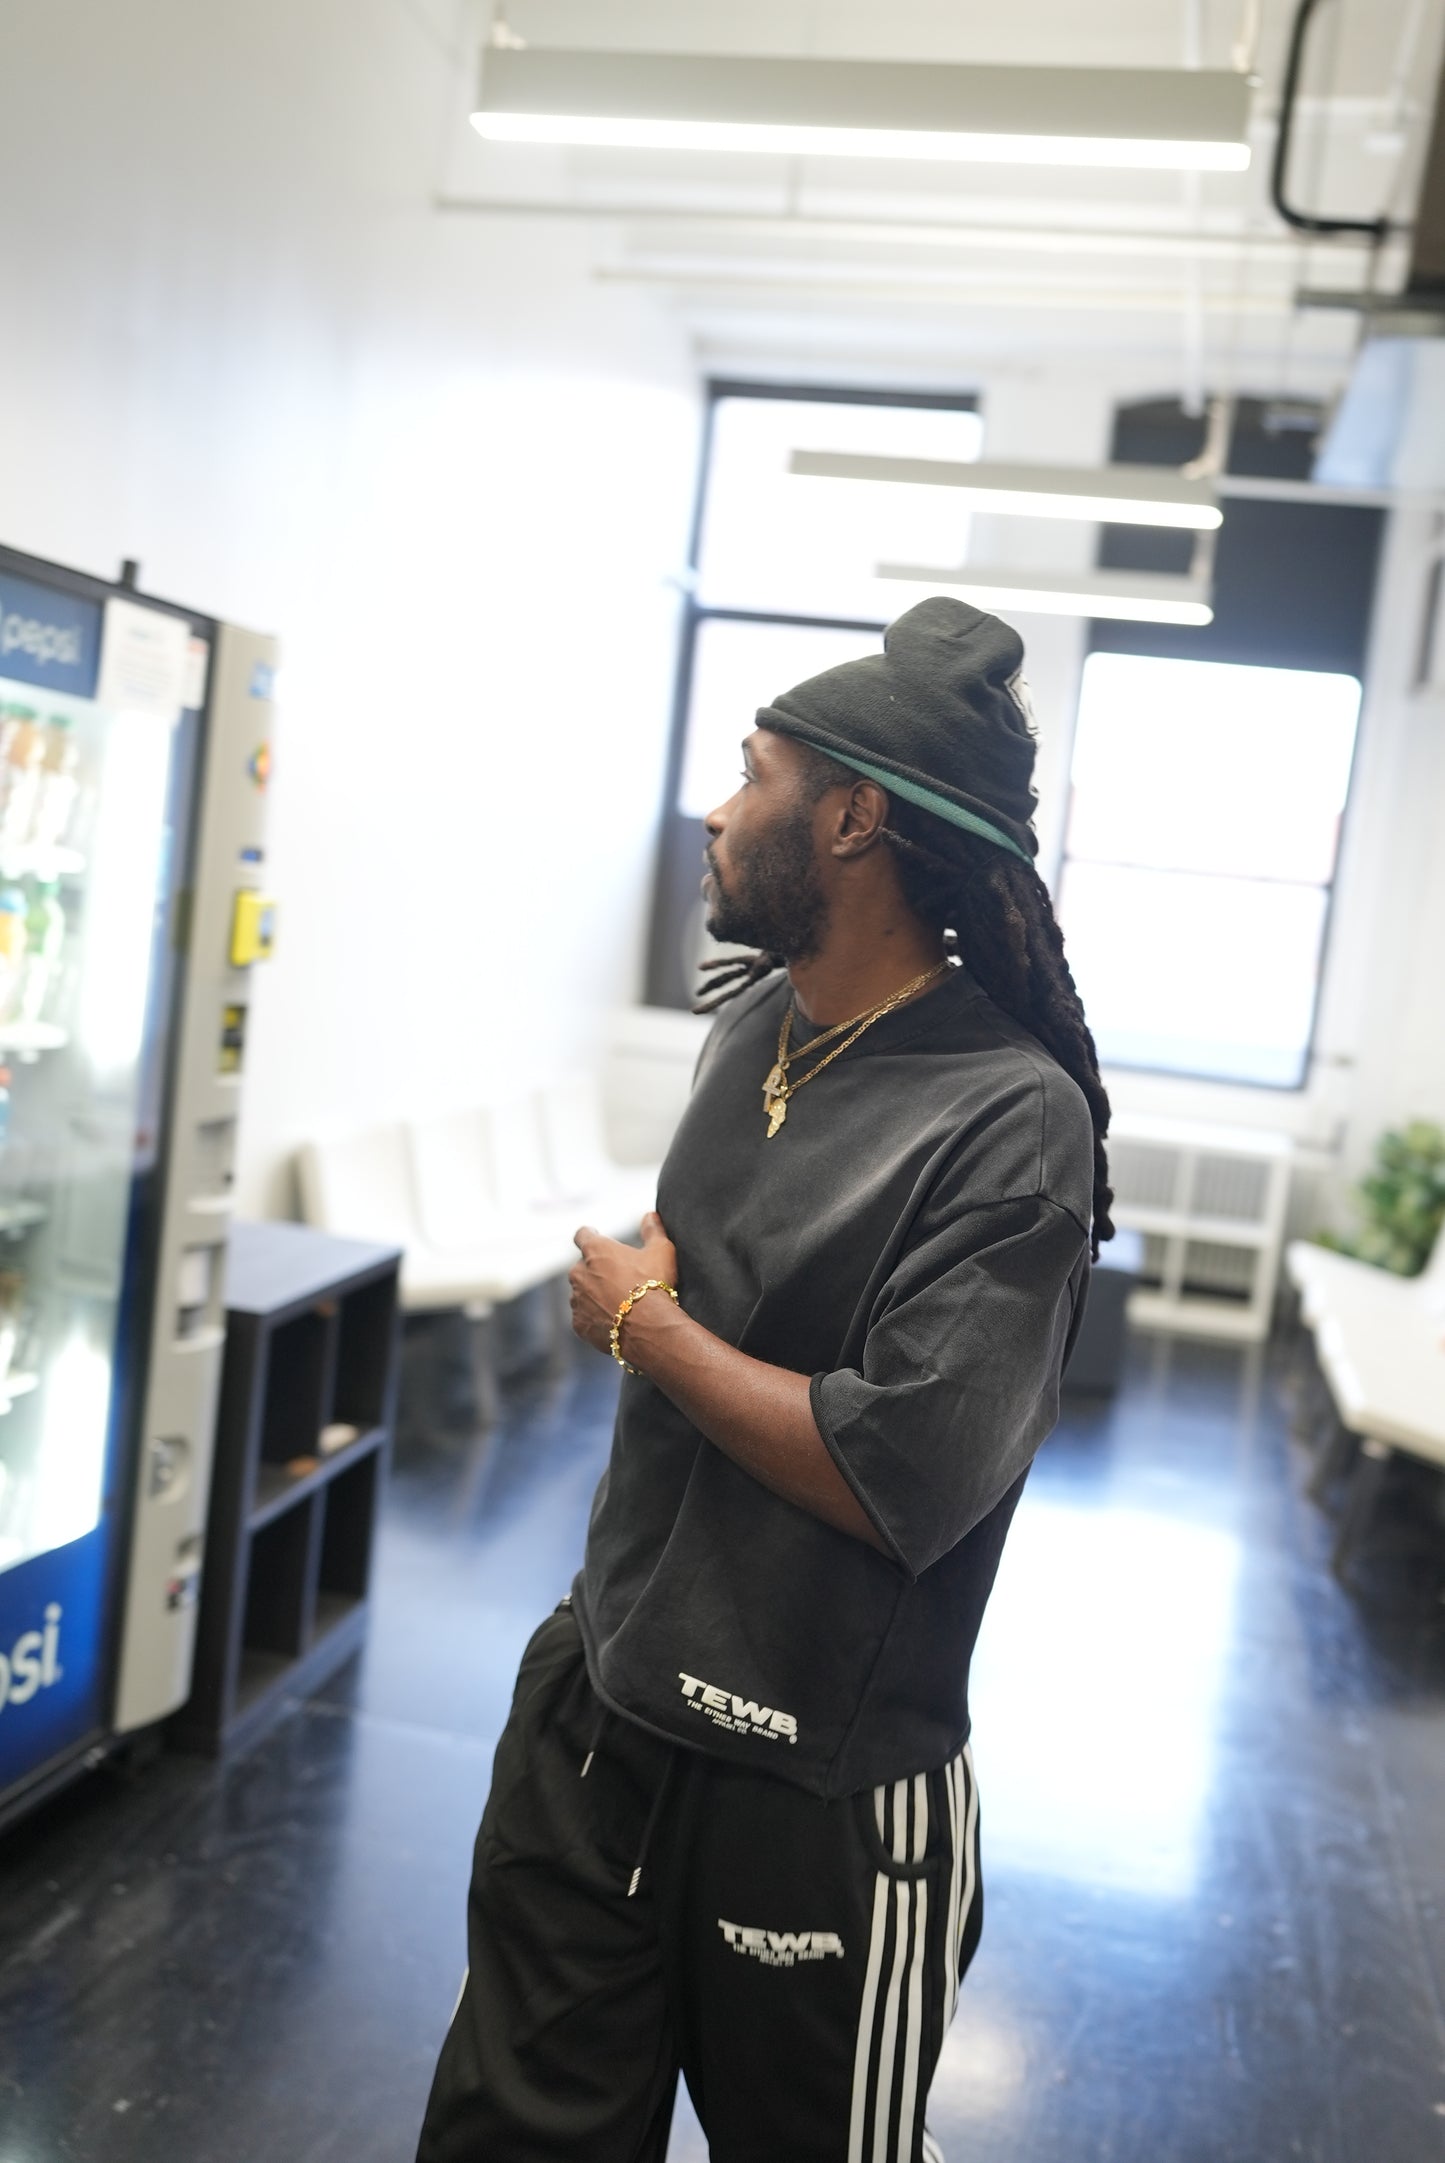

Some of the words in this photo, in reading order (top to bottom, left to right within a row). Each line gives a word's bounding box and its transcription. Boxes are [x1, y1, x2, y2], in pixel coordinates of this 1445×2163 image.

[678, 1672, 798, 1736] TEWB
[686, 1699, 703, 1712] THE
[704, 1708, 732, 1725] EITHER
[733, 1719, 751, 1730] WAY
[752, 1725, 779, 1740] BRAND
